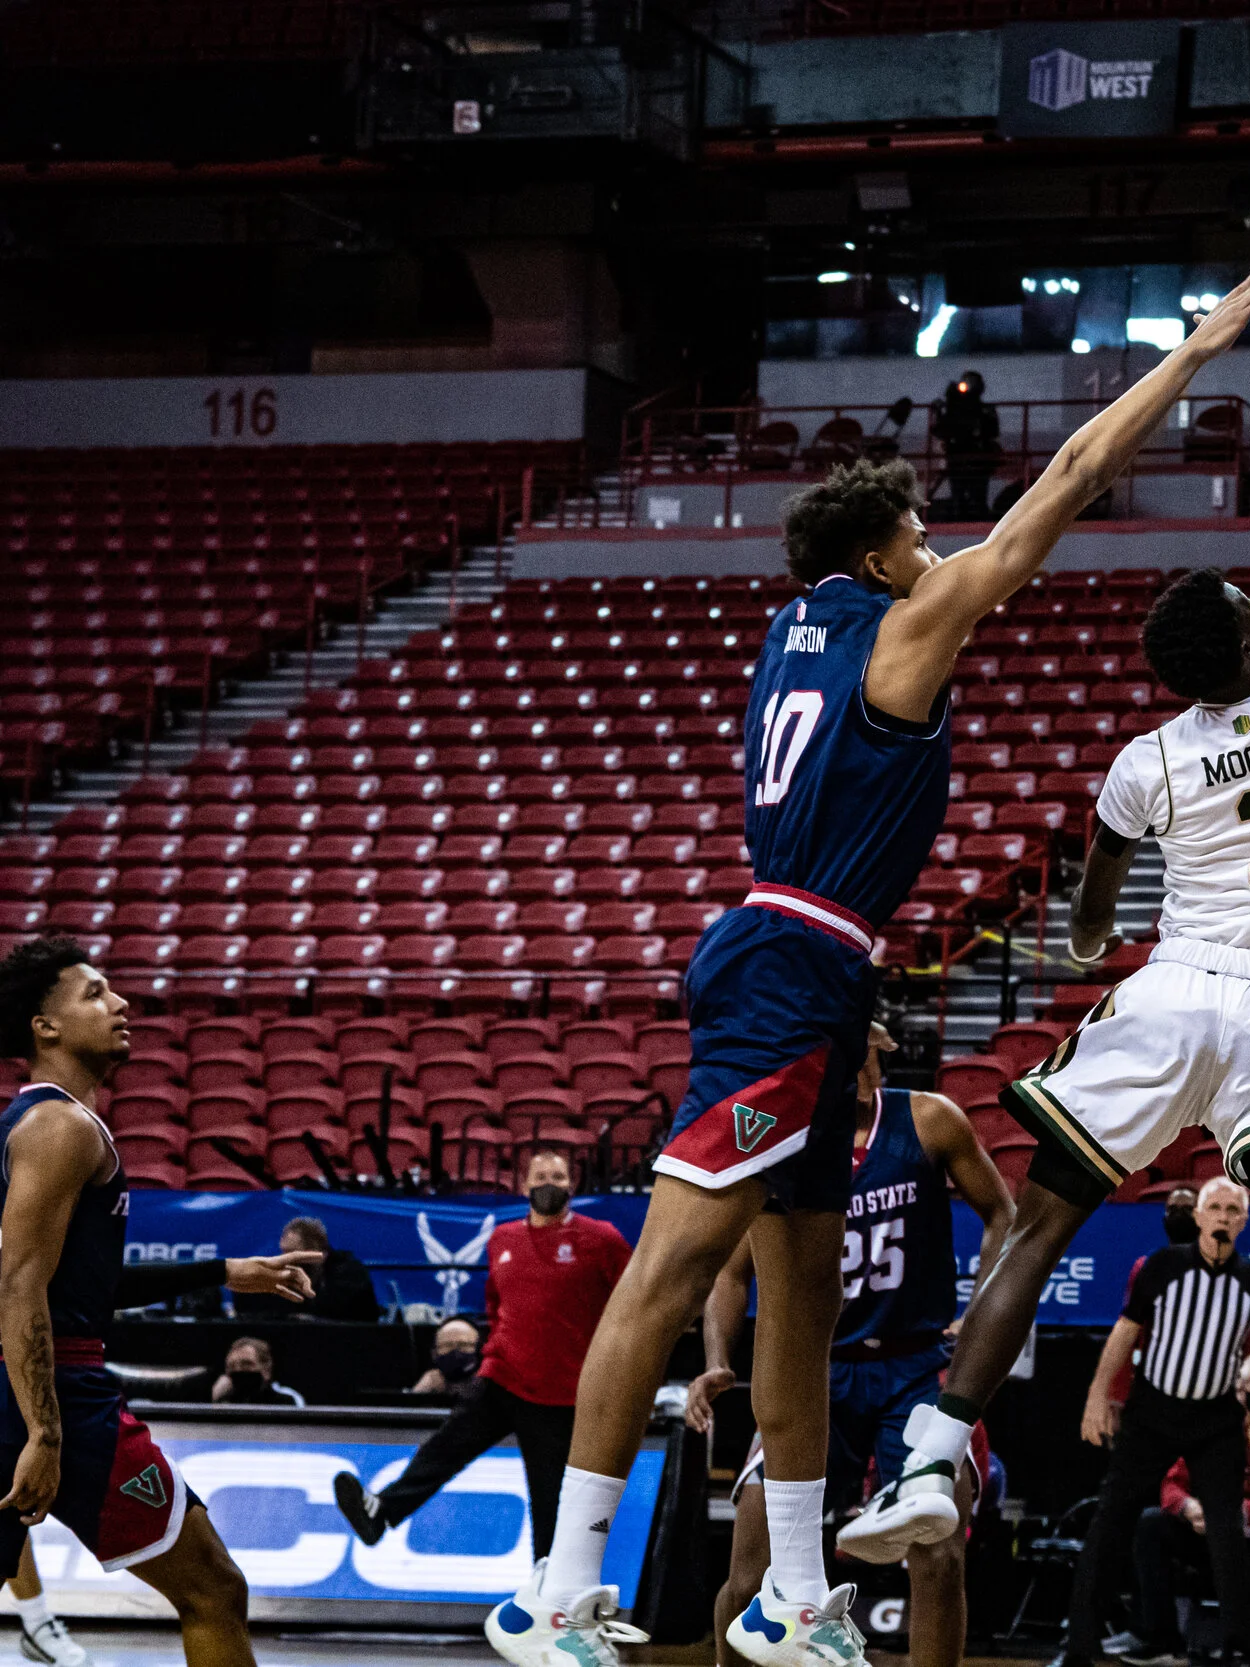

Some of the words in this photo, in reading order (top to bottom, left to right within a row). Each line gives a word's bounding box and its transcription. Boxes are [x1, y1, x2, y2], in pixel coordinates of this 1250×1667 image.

[1090, 75, 1152, 99] WEST
[204, 389, 277, 437] 116
[755, 689, 824, 807] 10
[731, 1102, 778, 1153] V
[865, 1181, 917, 1214] STATE
[123, 1241, 218, 1267] ORCE
[840, 1217, 905, 1299] 25
[119, 1463, 167, 1508] V
